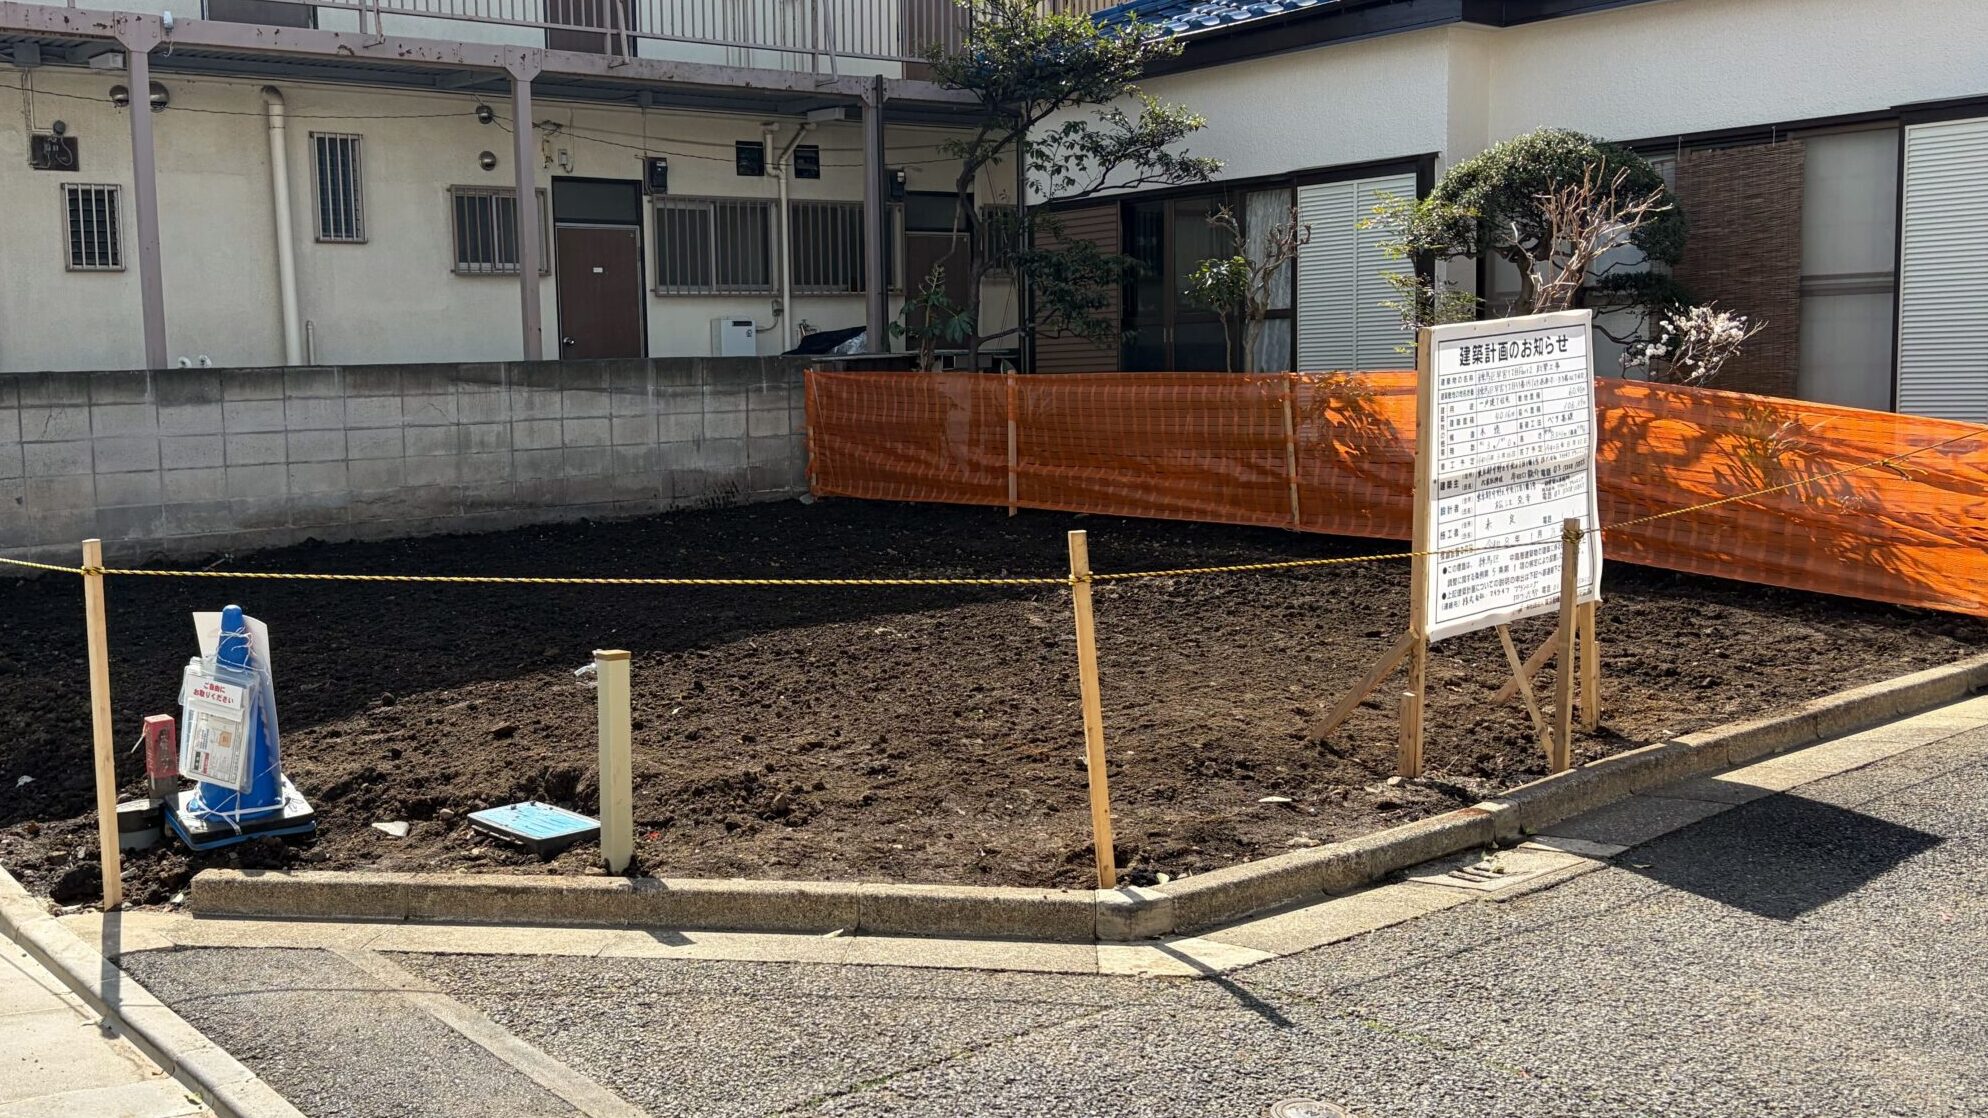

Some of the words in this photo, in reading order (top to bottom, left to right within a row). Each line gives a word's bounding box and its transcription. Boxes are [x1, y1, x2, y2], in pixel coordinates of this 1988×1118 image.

[1459, 334, 1569, 367] 建築計画のお知らせ
[203, 681, 226, 694] ご自由に
[193, 688, 235, 704] お取りください
